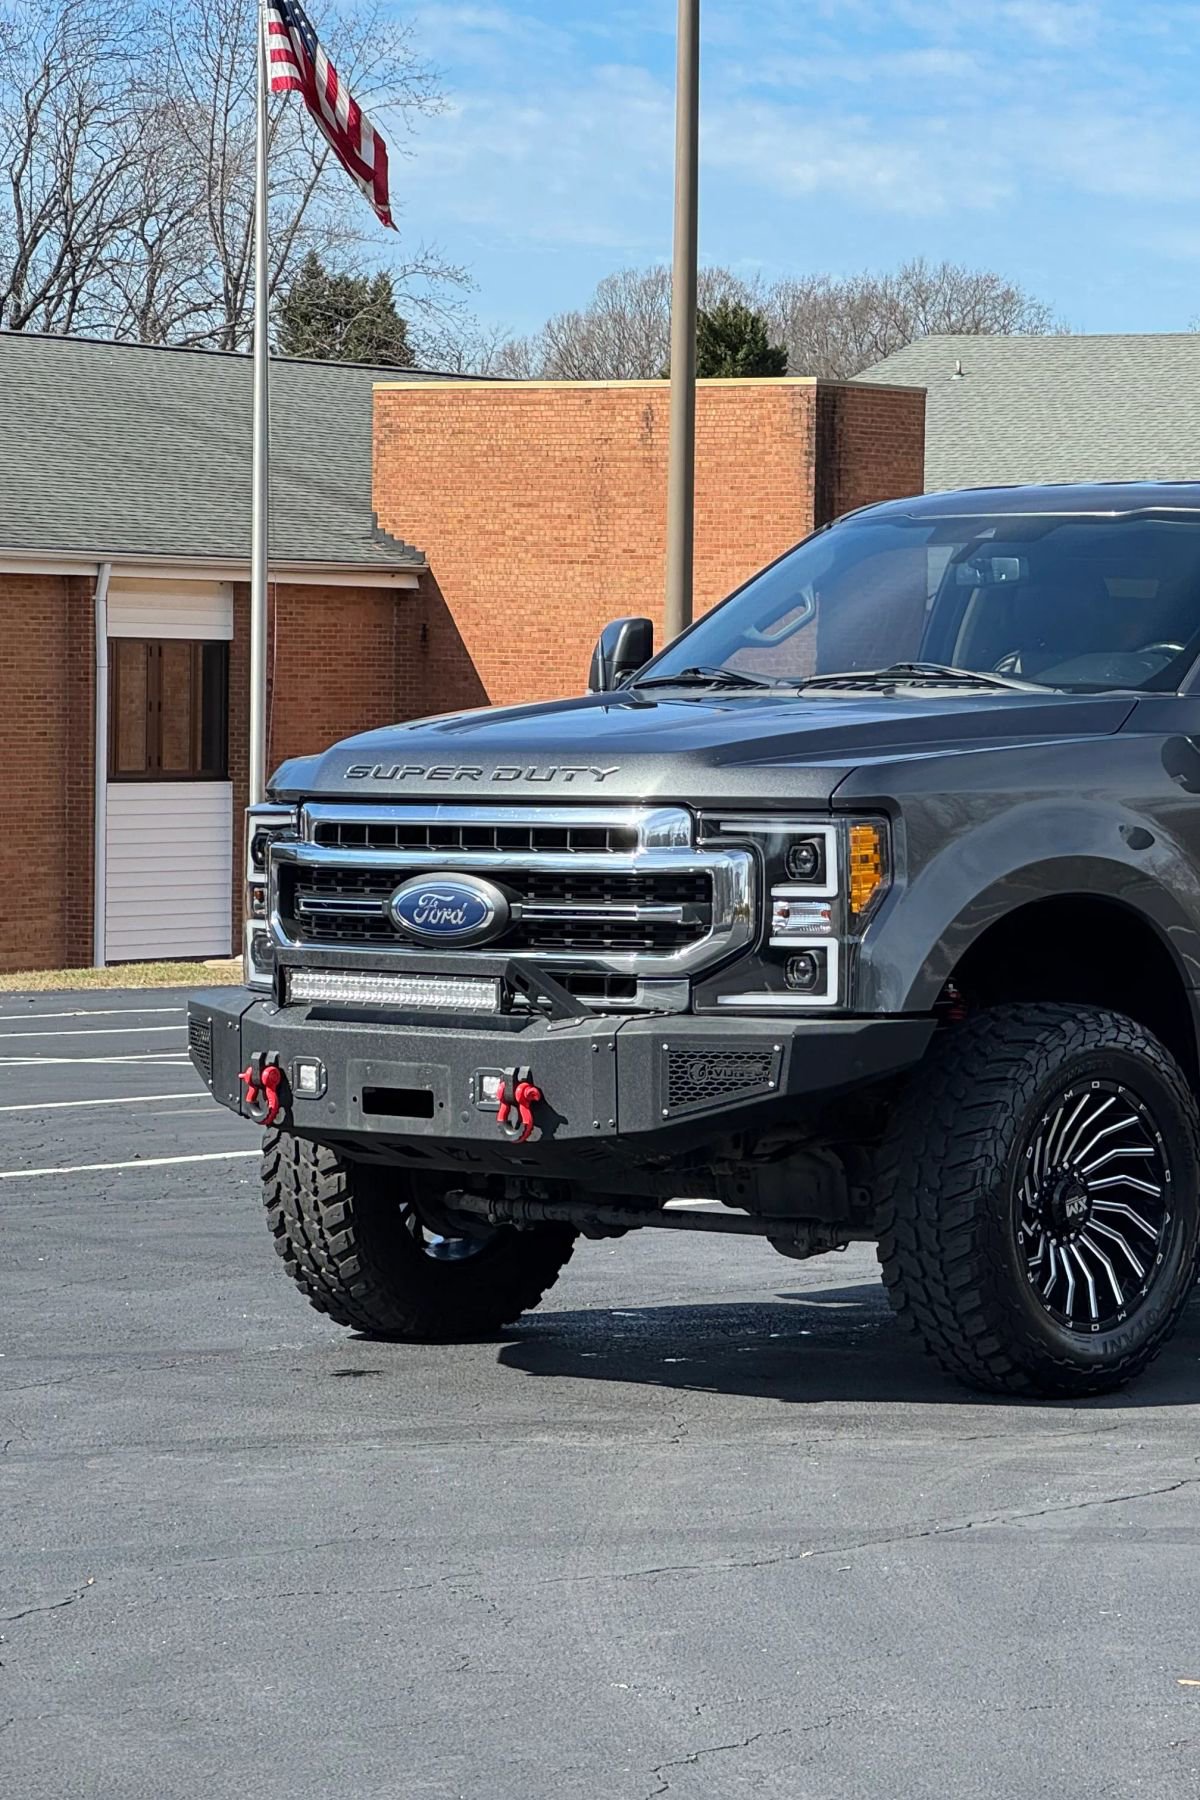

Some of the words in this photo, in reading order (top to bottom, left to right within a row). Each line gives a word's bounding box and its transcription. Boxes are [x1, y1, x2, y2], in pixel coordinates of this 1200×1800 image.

[344, 764, 484, 782] SUPER
[489, 765, 621, 783] DUTY
[413, 893, 468, 925] Ford
